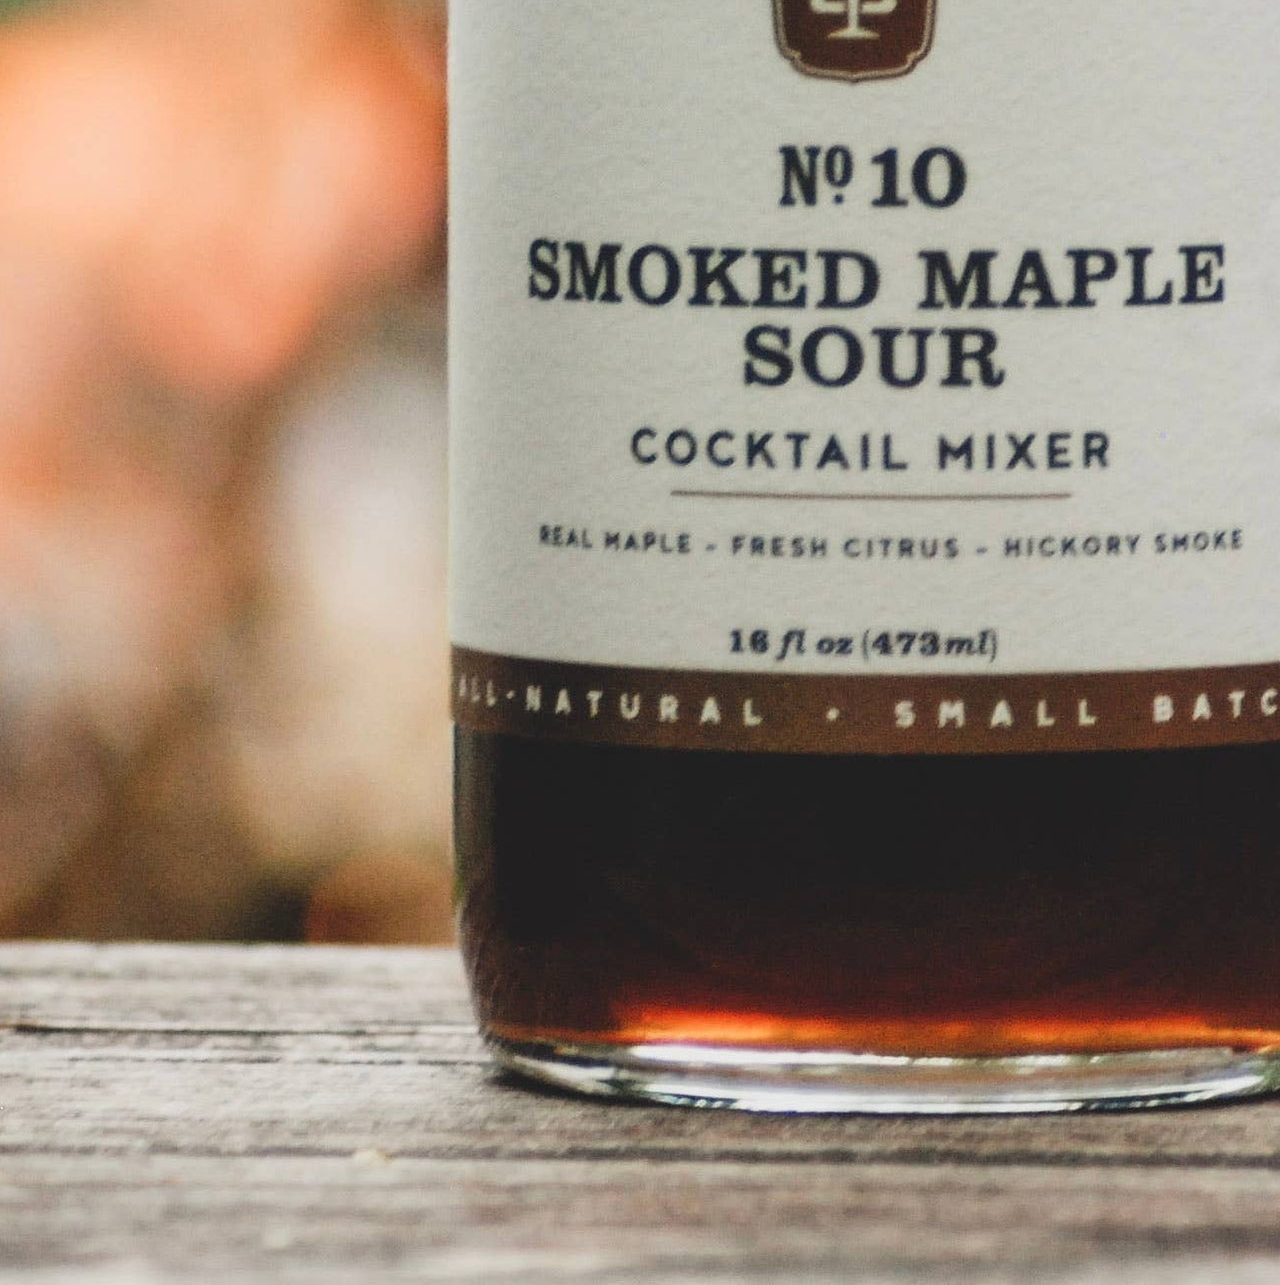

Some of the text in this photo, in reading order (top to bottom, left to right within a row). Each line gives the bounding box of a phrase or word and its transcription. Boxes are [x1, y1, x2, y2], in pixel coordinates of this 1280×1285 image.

[871, 147, 967, 208] 10
[527, 240, 1227, 311] SMOKED MAPLE
[743, 326, 1006, 387] SOUR
[629, 427, 1112, 471] COCKTAIL MIXER
[539, 525, 592, 549] REAL
[604, 531, 691, 554] MAPLE
[732, 535, 827, 558] FRESH
[843, 536, 959, 559] CITRUS
[1005, 534, 1141, 558] HICKORY
[1154, 528, 1243, 554] SMOKE
[730, 628, 998, 663] 16 fl oz (473ml)
[894, 698, 1098, 728] SMALL
